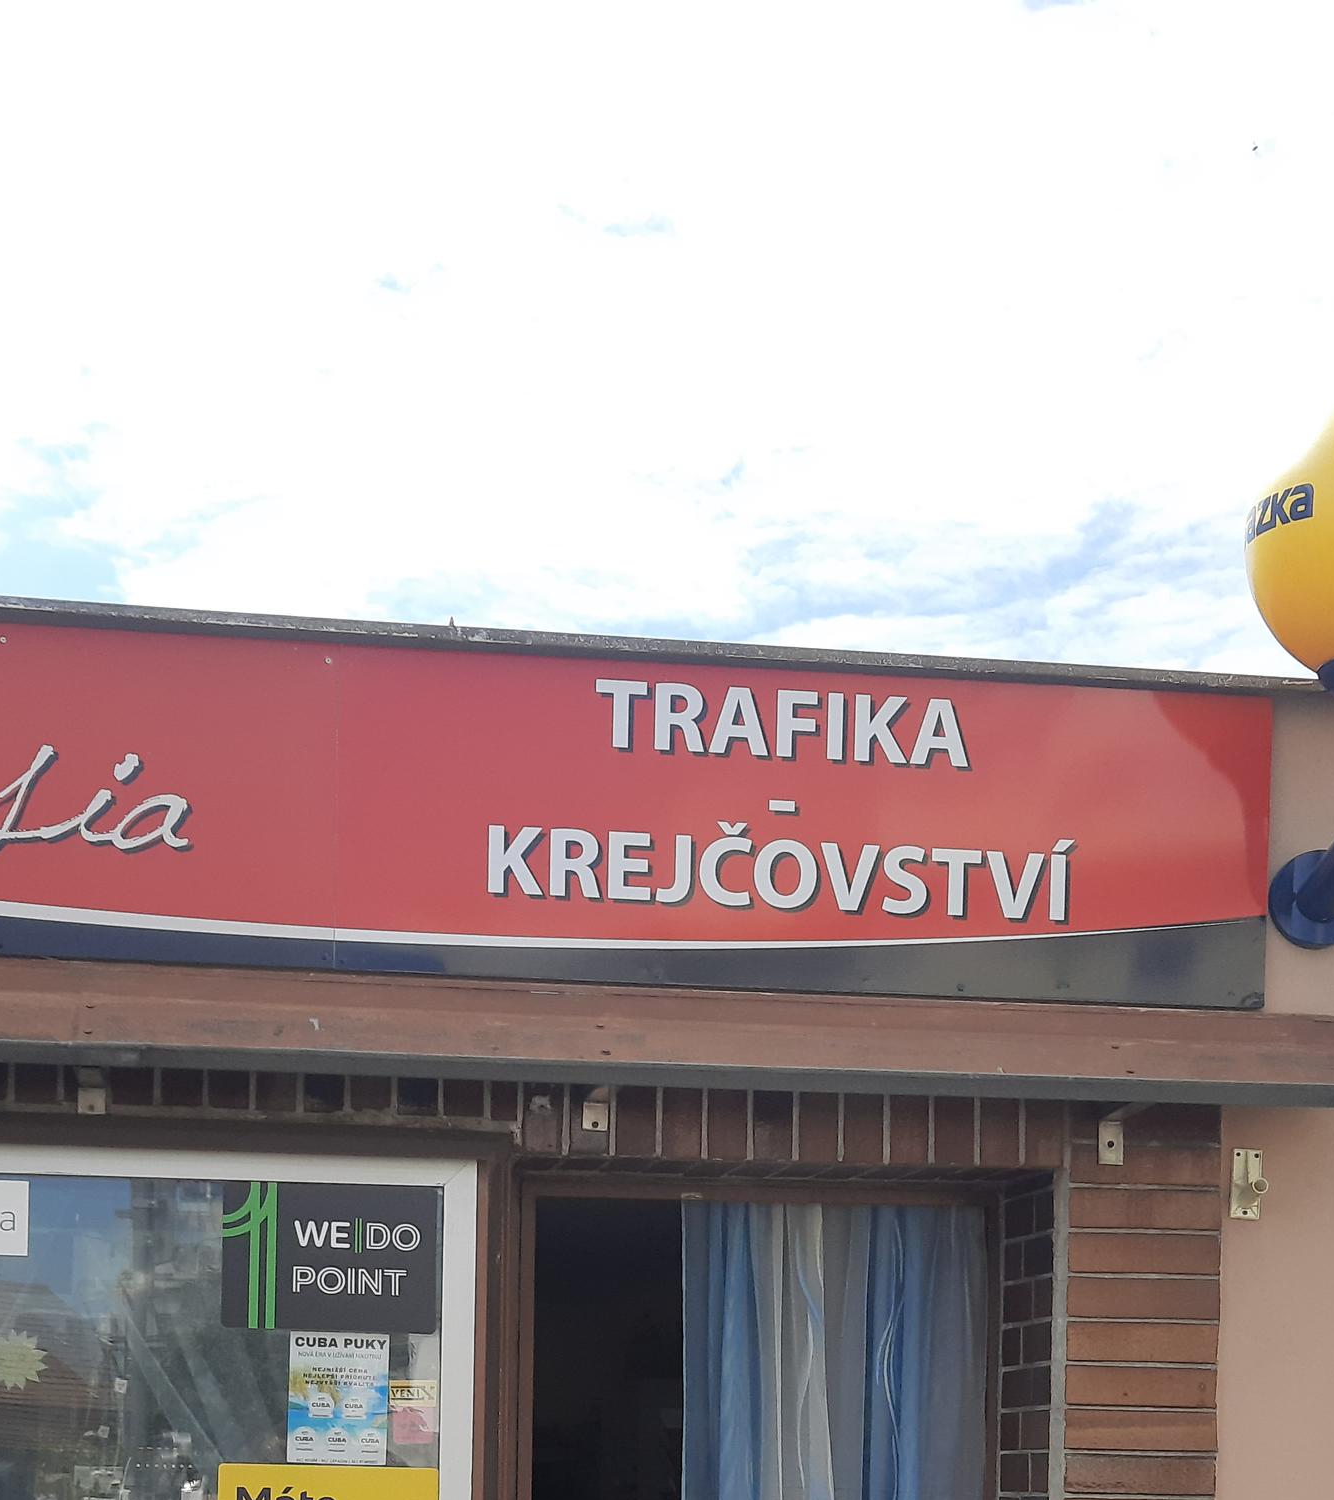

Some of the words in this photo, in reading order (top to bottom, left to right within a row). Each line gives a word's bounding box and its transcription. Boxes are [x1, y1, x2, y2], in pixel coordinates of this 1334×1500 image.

[1245, 482, 1315, 550] azka
[595, 678, 972, 771] TRAFIKA
[485, 820, 1077, 926] KREJČOVSTVÍ
[292, 1265, 407, 1297] POINT
[295, 1336, 339, 1349] CUBA
[343, 1338, 387, 1351] PUKY
